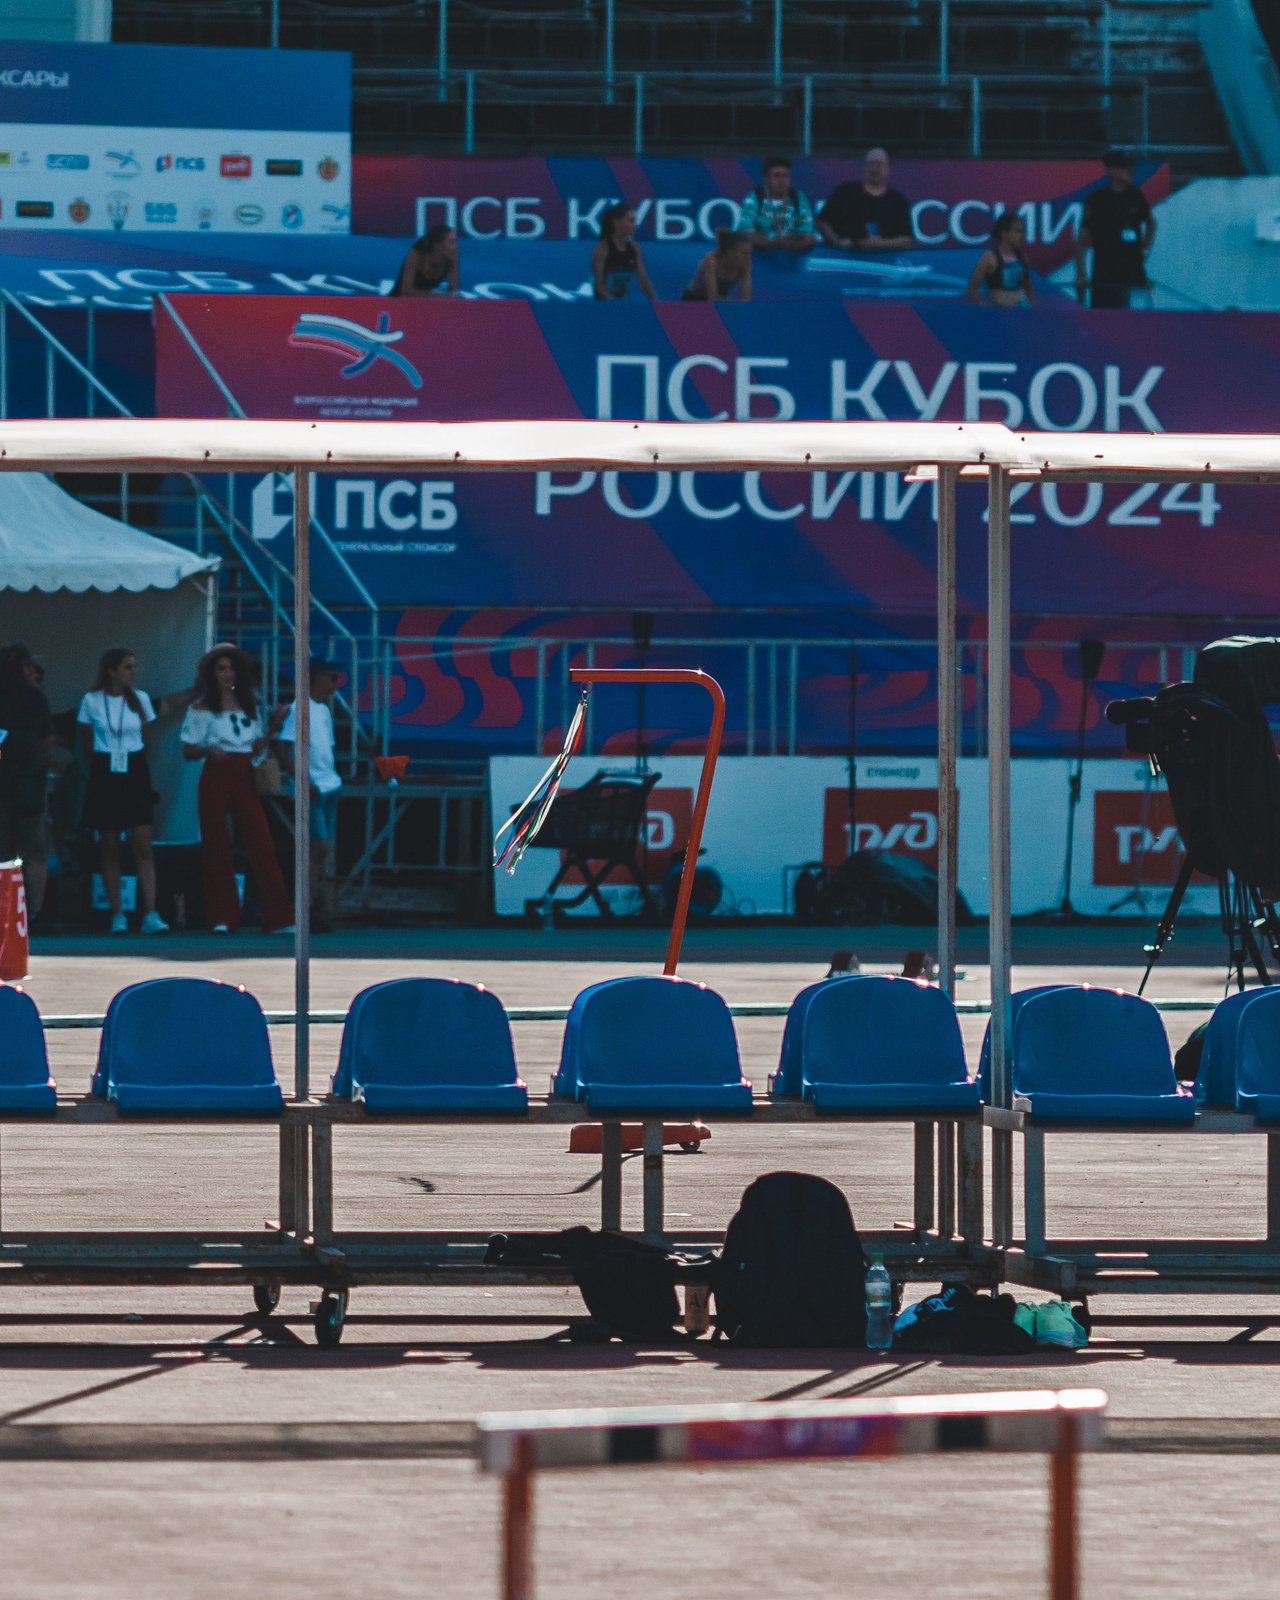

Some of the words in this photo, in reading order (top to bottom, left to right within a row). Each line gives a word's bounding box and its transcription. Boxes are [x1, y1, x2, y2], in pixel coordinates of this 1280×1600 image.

[415, 196, 546, 241] ПСБ
[38, 269, 255, 291] ПСБ
[596, 354, 796, 422] ПСБ
[830, 359, 1165, 432] КУБОК
[335, 479, 458, 531] ПСБ
[534, 471, 939, 521] РОССИИ
